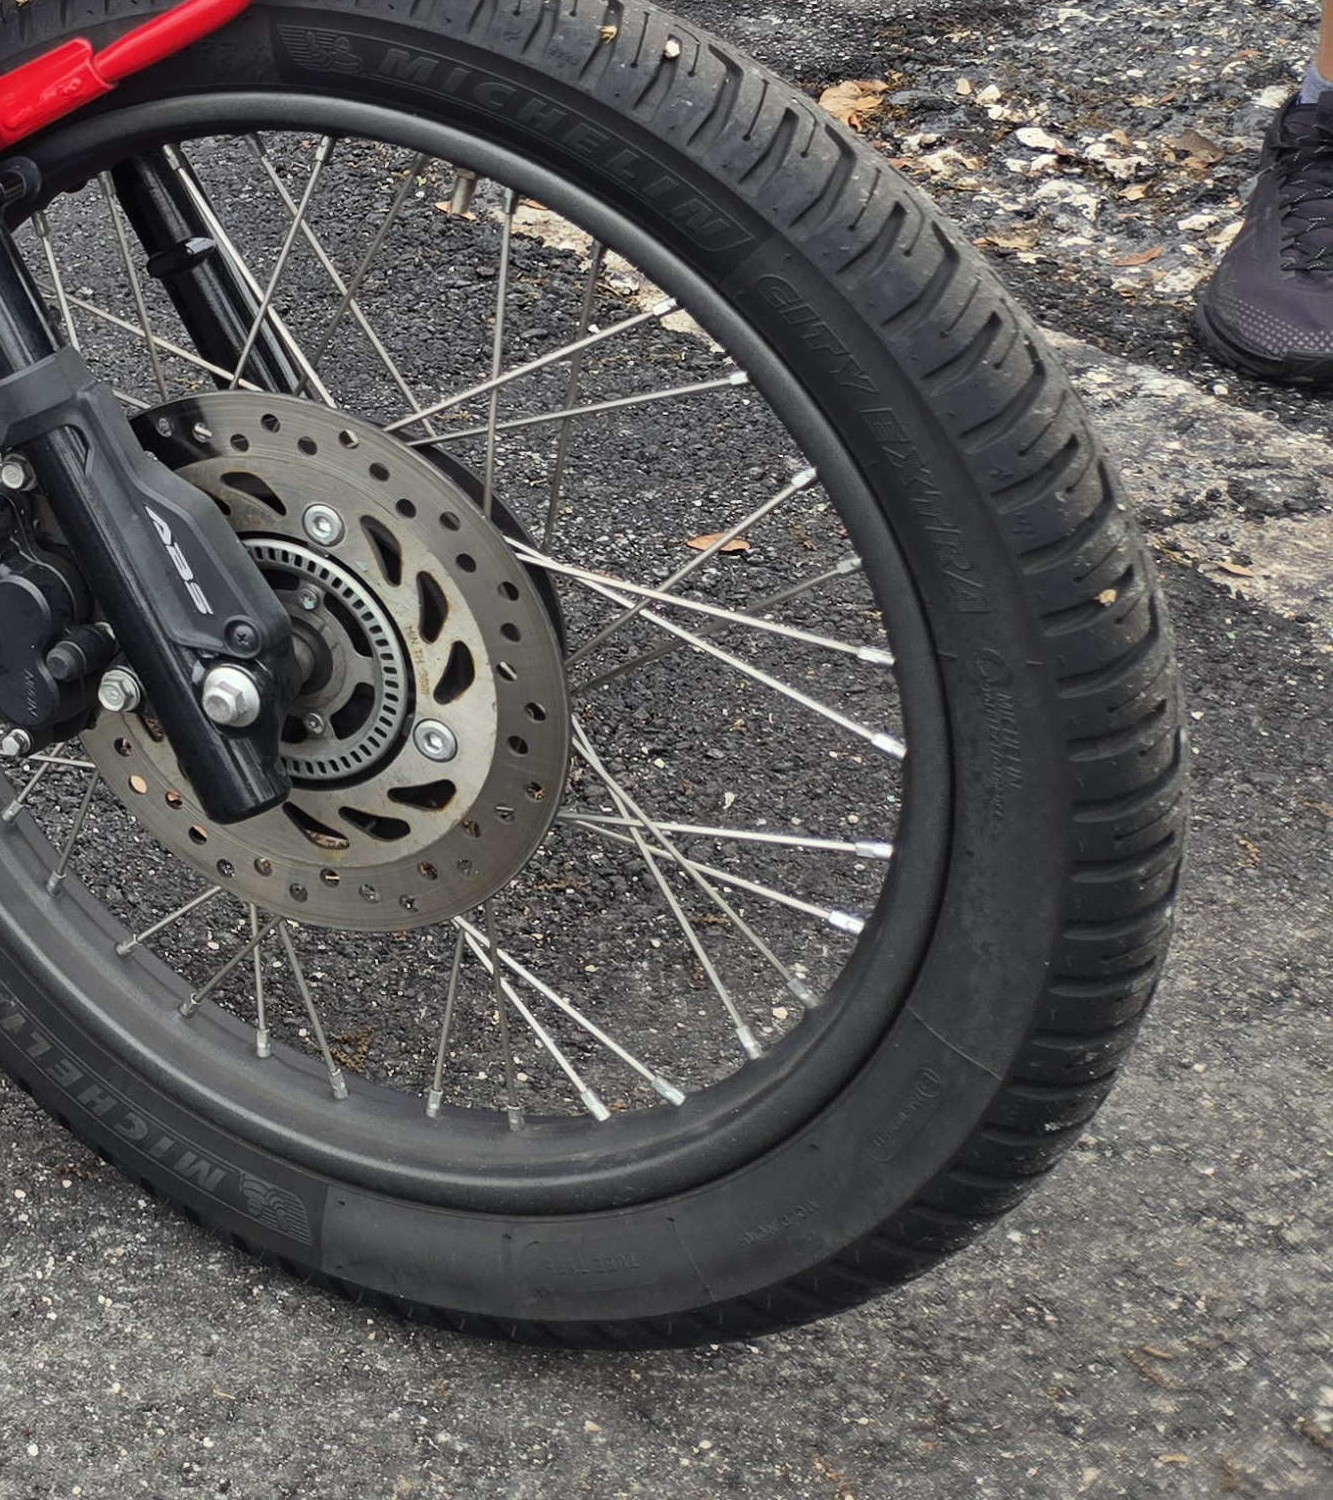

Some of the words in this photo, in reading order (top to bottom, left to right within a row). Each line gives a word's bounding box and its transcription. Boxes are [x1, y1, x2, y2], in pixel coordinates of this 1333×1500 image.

[375, 41, 741, 253] MICHELIN
[751, 272, 883, 397] CITY
[858, 407, 995, 617] EXTRA
[144, 504, 214, 616] ABS
